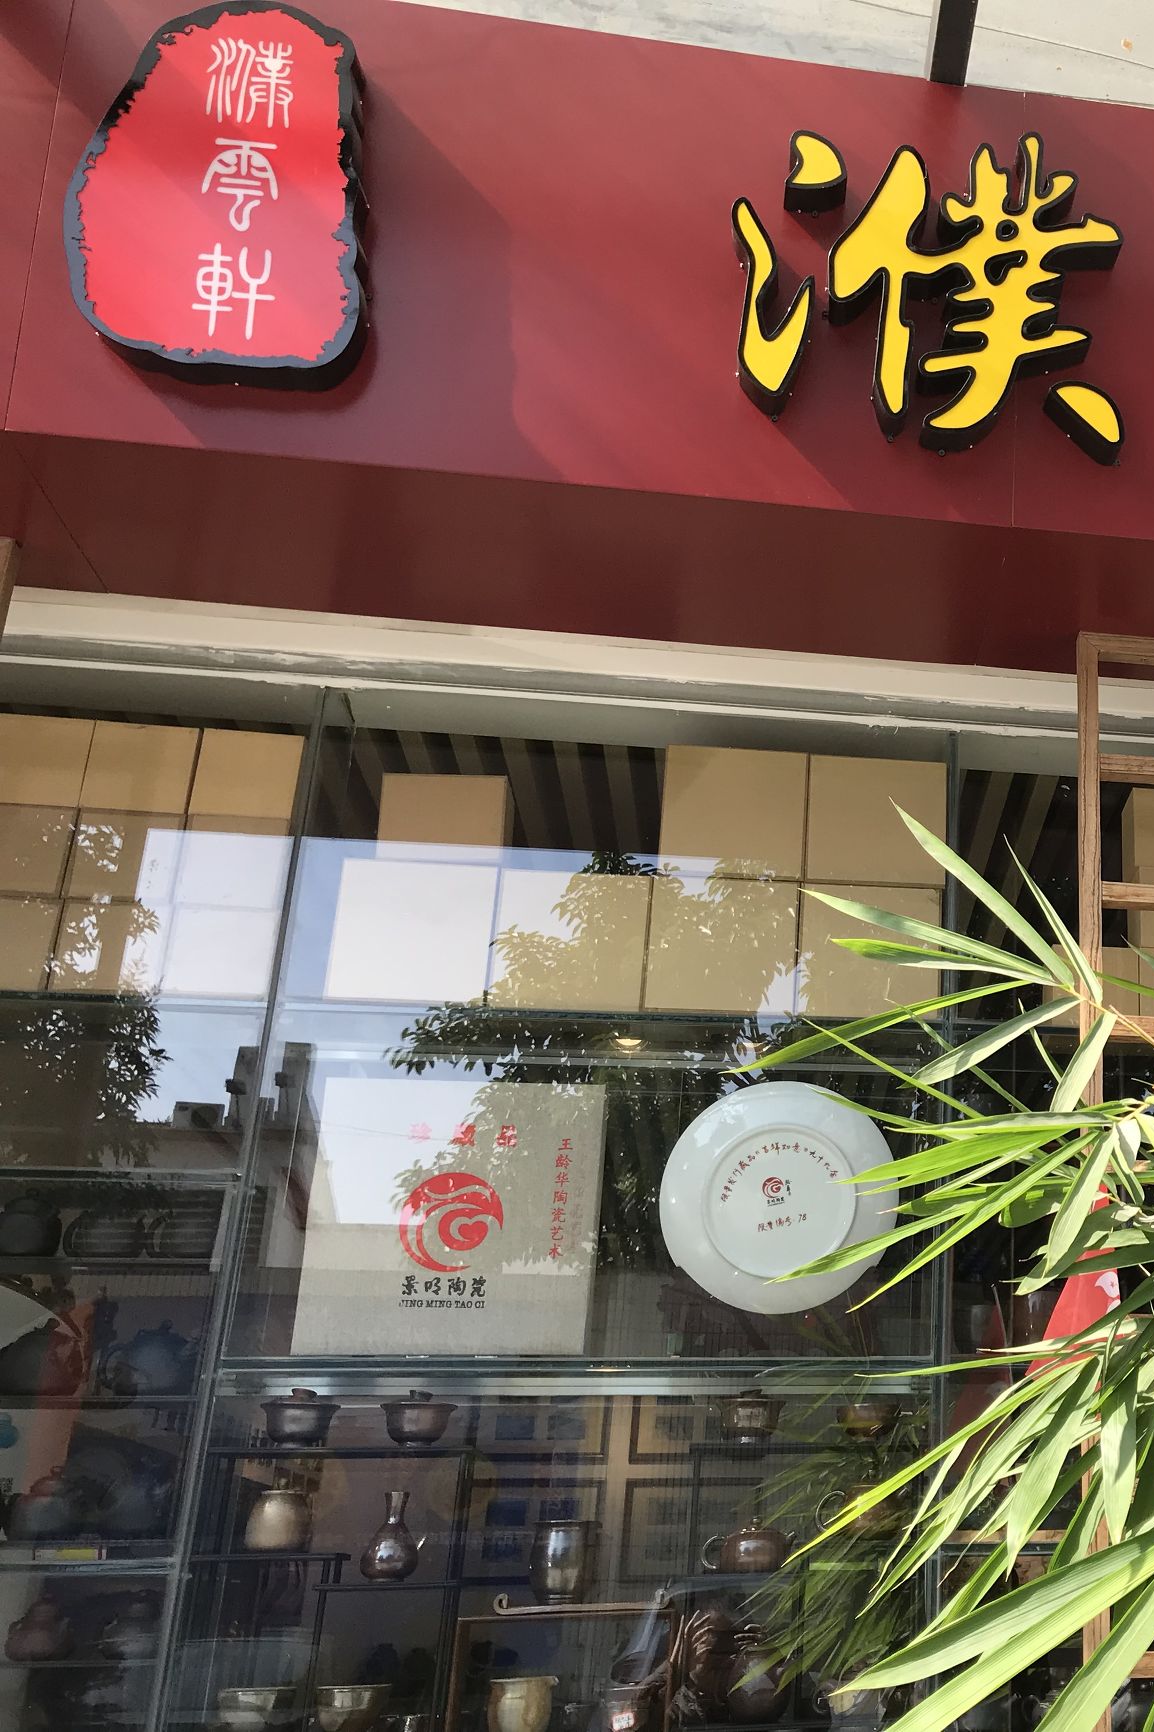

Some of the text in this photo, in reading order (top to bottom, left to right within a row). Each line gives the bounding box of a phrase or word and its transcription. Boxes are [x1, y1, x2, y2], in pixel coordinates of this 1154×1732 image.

[548, 1138, 574, 1259] 王龄华陶瓷艺术
[425, 1299, 453, 1309] MING
[454, 1300, 473, 1309] TAO
